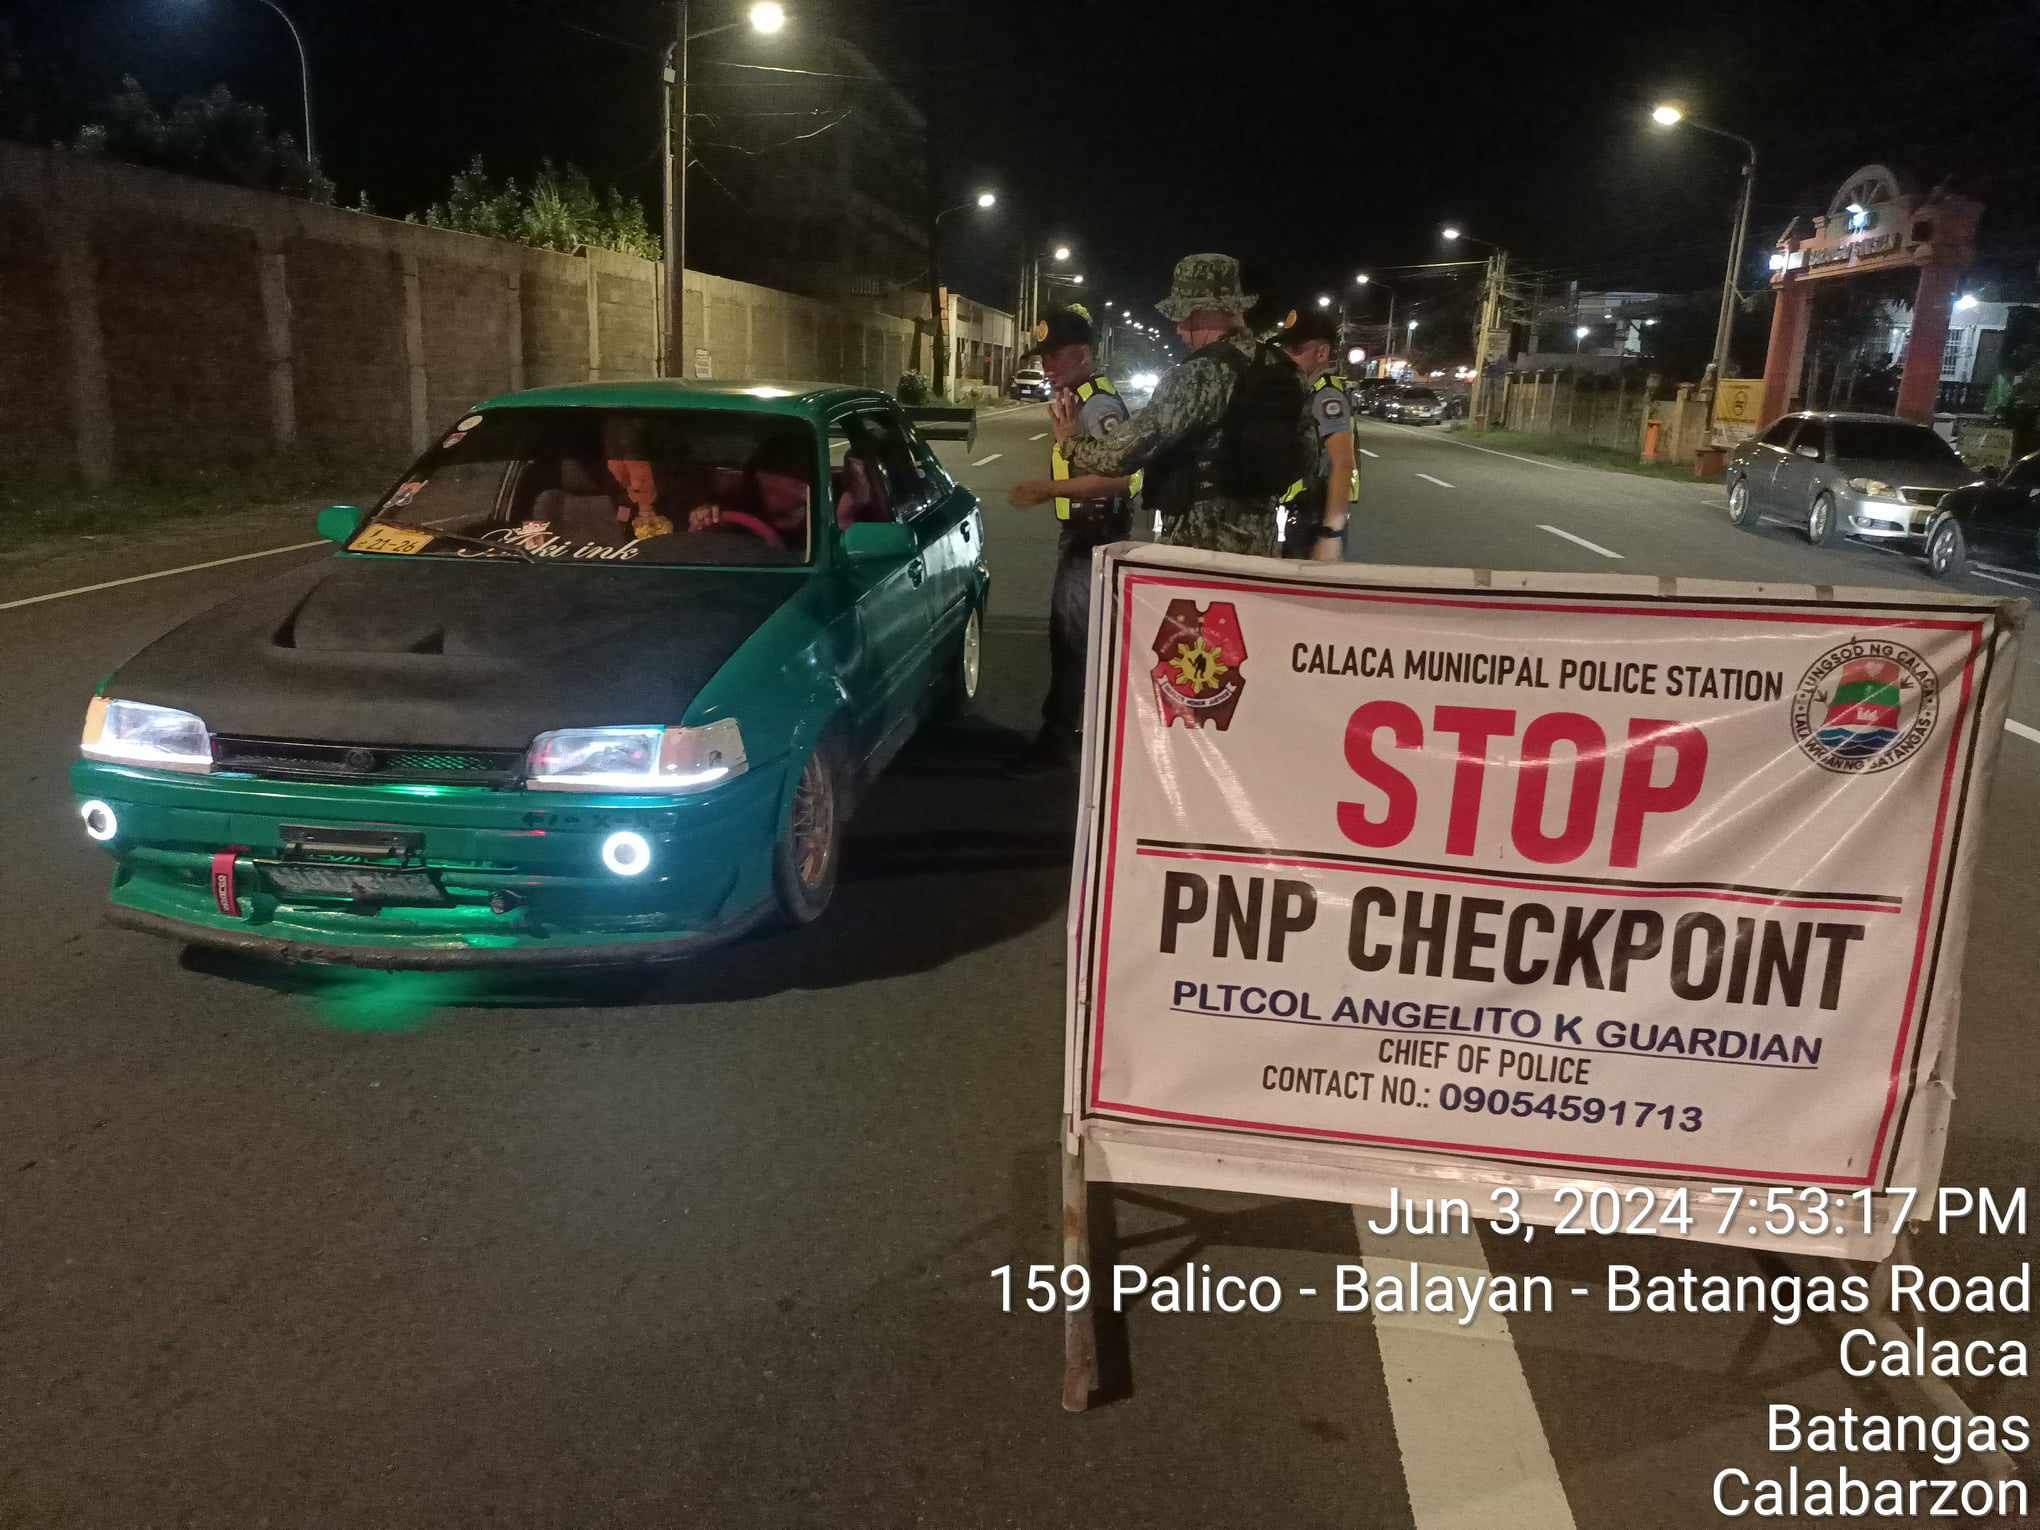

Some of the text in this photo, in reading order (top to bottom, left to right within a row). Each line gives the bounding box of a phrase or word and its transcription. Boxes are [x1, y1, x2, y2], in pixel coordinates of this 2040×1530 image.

[1291, 642, 1784, 702] CALACA MUNICIPAL POLICE STATION
[1803, 645, 1864, 694] LUNGSOD
[1870, 644, 1893, 656] NG
[1336, 700, 1708, 868] STOP
[1160, 870, 1865, 1010] PNP CHECKPOINT
[1172, 980, 1823, 1065] PLTCOL ANGELITO K GUARDIAN
[1379, 1038, 1592, 1085] CHIEF OF POLICE
[1262, 1065, 1704, 1132] CONTACT NO.: 09054591713
